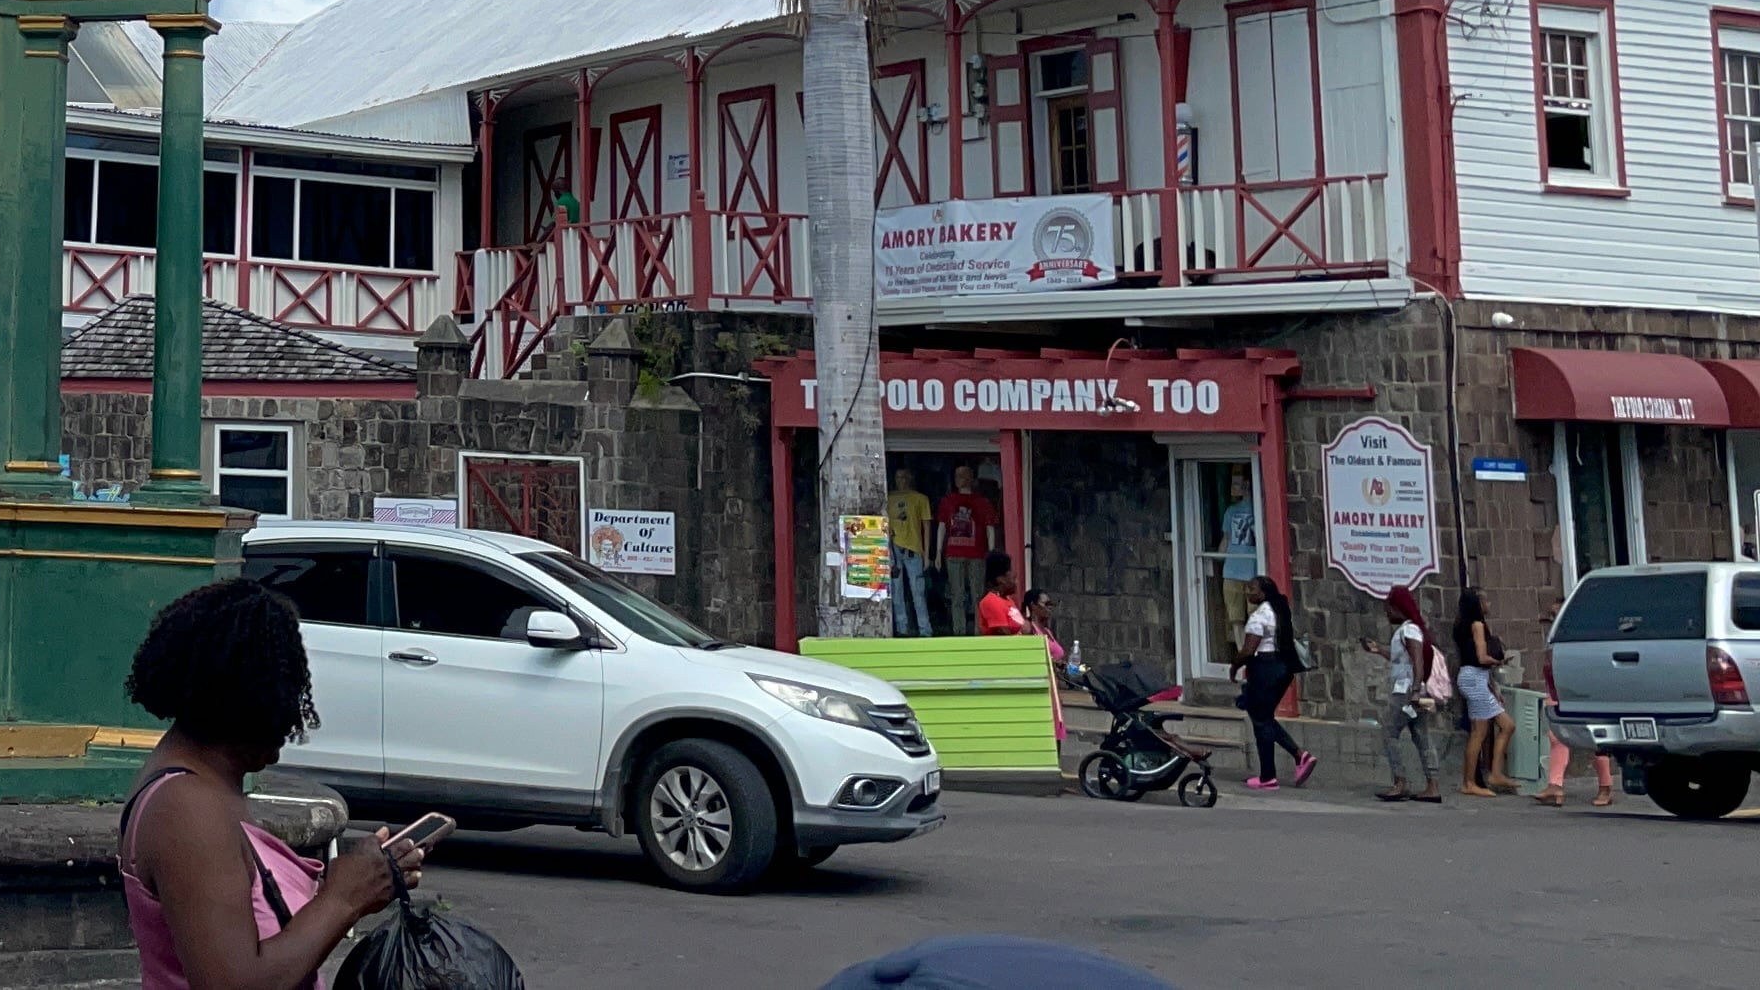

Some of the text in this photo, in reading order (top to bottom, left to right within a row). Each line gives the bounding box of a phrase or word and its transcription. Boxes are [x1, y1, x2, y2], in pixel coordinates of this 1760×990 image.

[881, 221, 1017, 249] AMORY BAKERY
[895, 265, 914, 275] Years
[968, 258, 1010, 270] Service
[960, 282, 974, 290] You
[879, 379, 944, 411] OLO
[1148, 379, 1219, 414] TOO
[1360, 435, 1387, 449] Visit
[1330, 455, 1421, 466] The Oldest & Famous
[594, 511, 671, 525] Department
[1333, 511, 1424, 528] AMORY BAKERY
[639, 528, 656, 539] Of
[624, 541, 673, 553] Culture
[1370, 543, 1383, 552] You
[1342, 553, 1347, 561] A
[1348, 554, 1368, 562] Name
[1371, 555, 1384, 563] You
